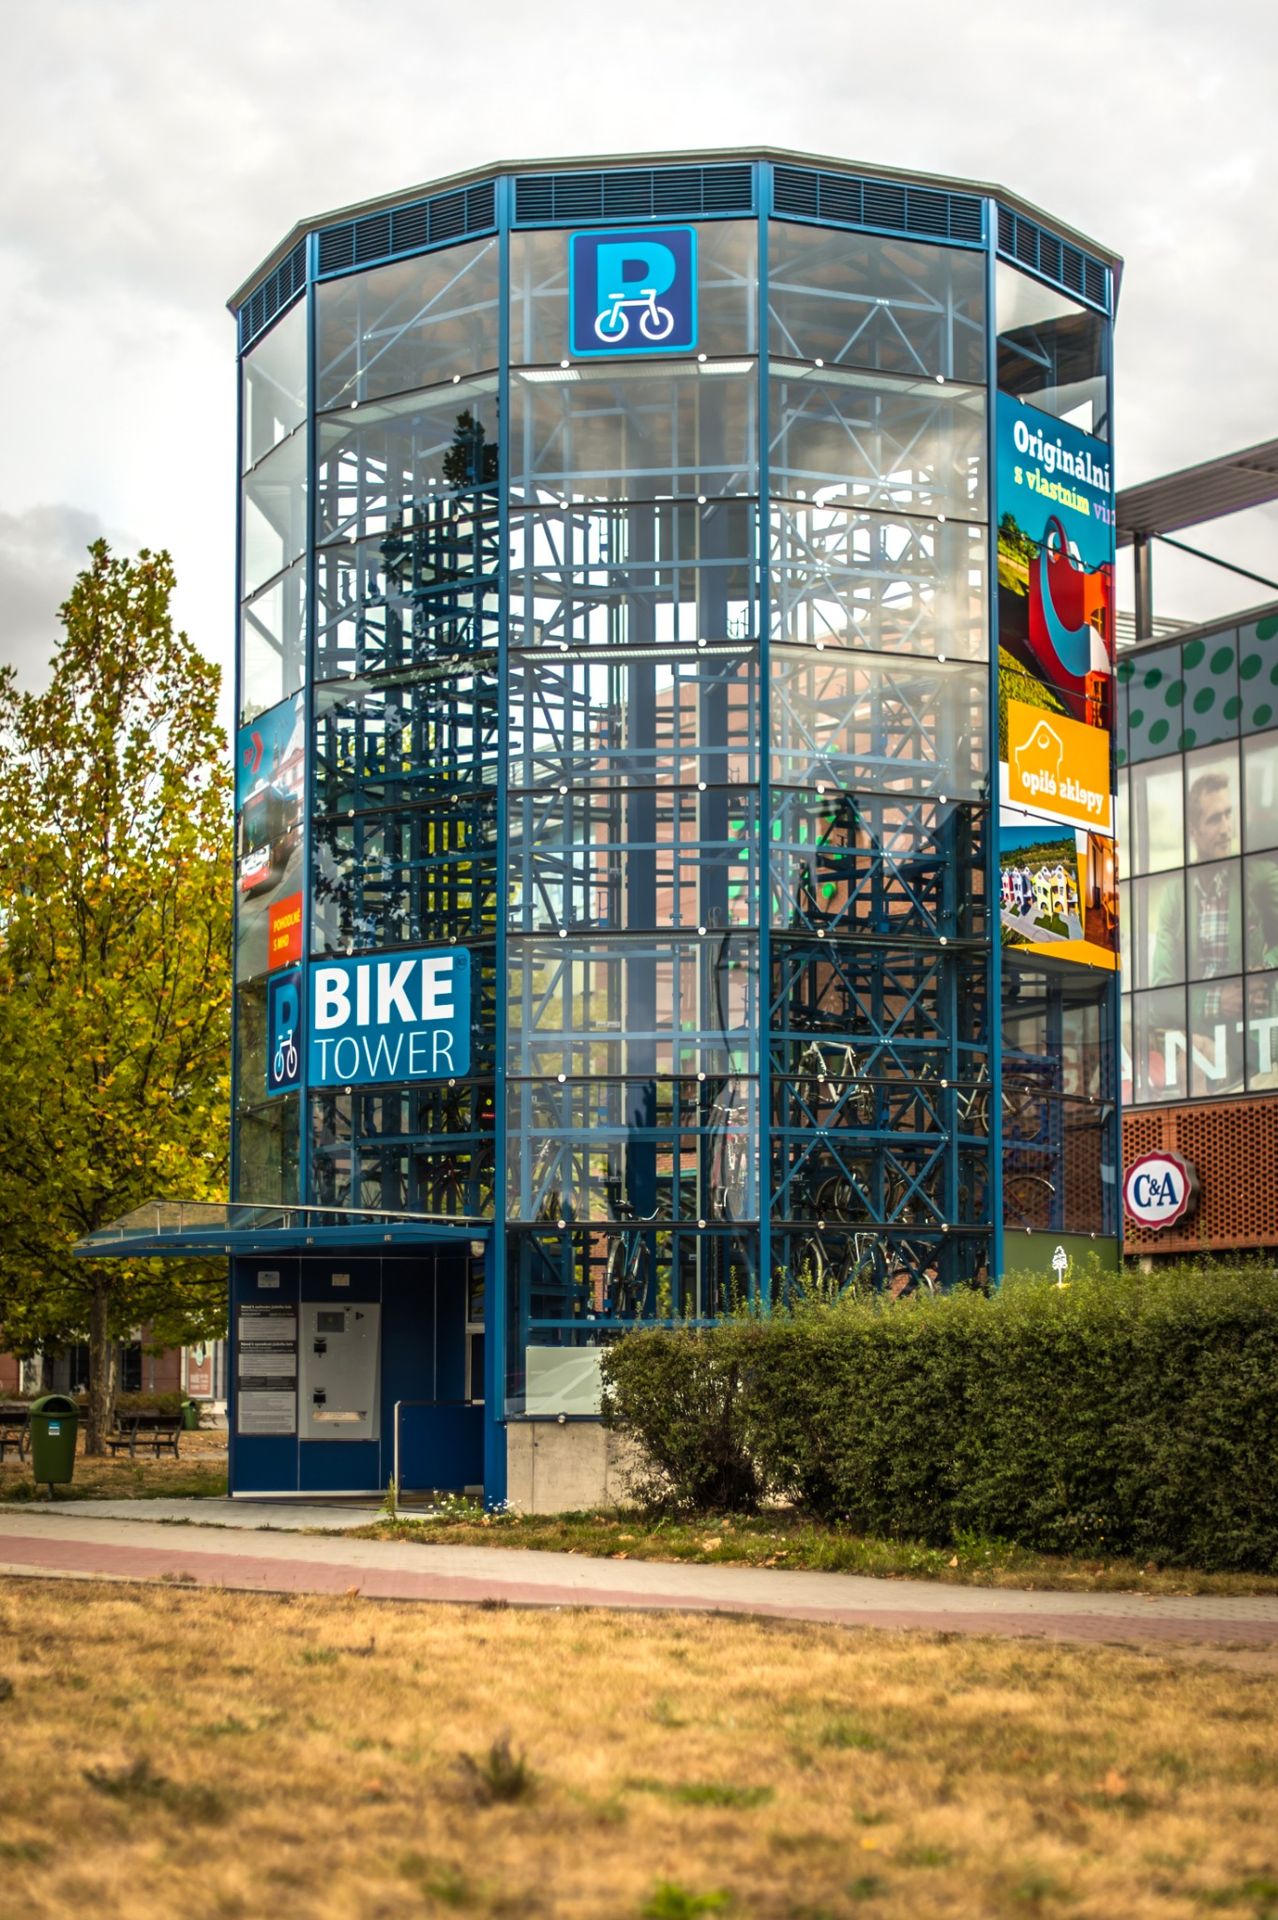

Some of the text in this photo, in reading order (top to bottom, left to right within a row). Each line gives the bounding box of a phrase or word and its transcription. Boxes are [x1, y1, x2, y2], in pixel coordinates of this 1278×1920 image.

[597, 241, 676, 333] P
[1013, 420, 1110, 493] Originální
[1025, 467, 1091, 517] vlastním
[1059, 777, 1104, 815] sklepy
[314, 956, 455, 1030] BIKE
[314, 1029, 455, 1081] TOWER
[1133, 1171, 1179, 1208] C&A
